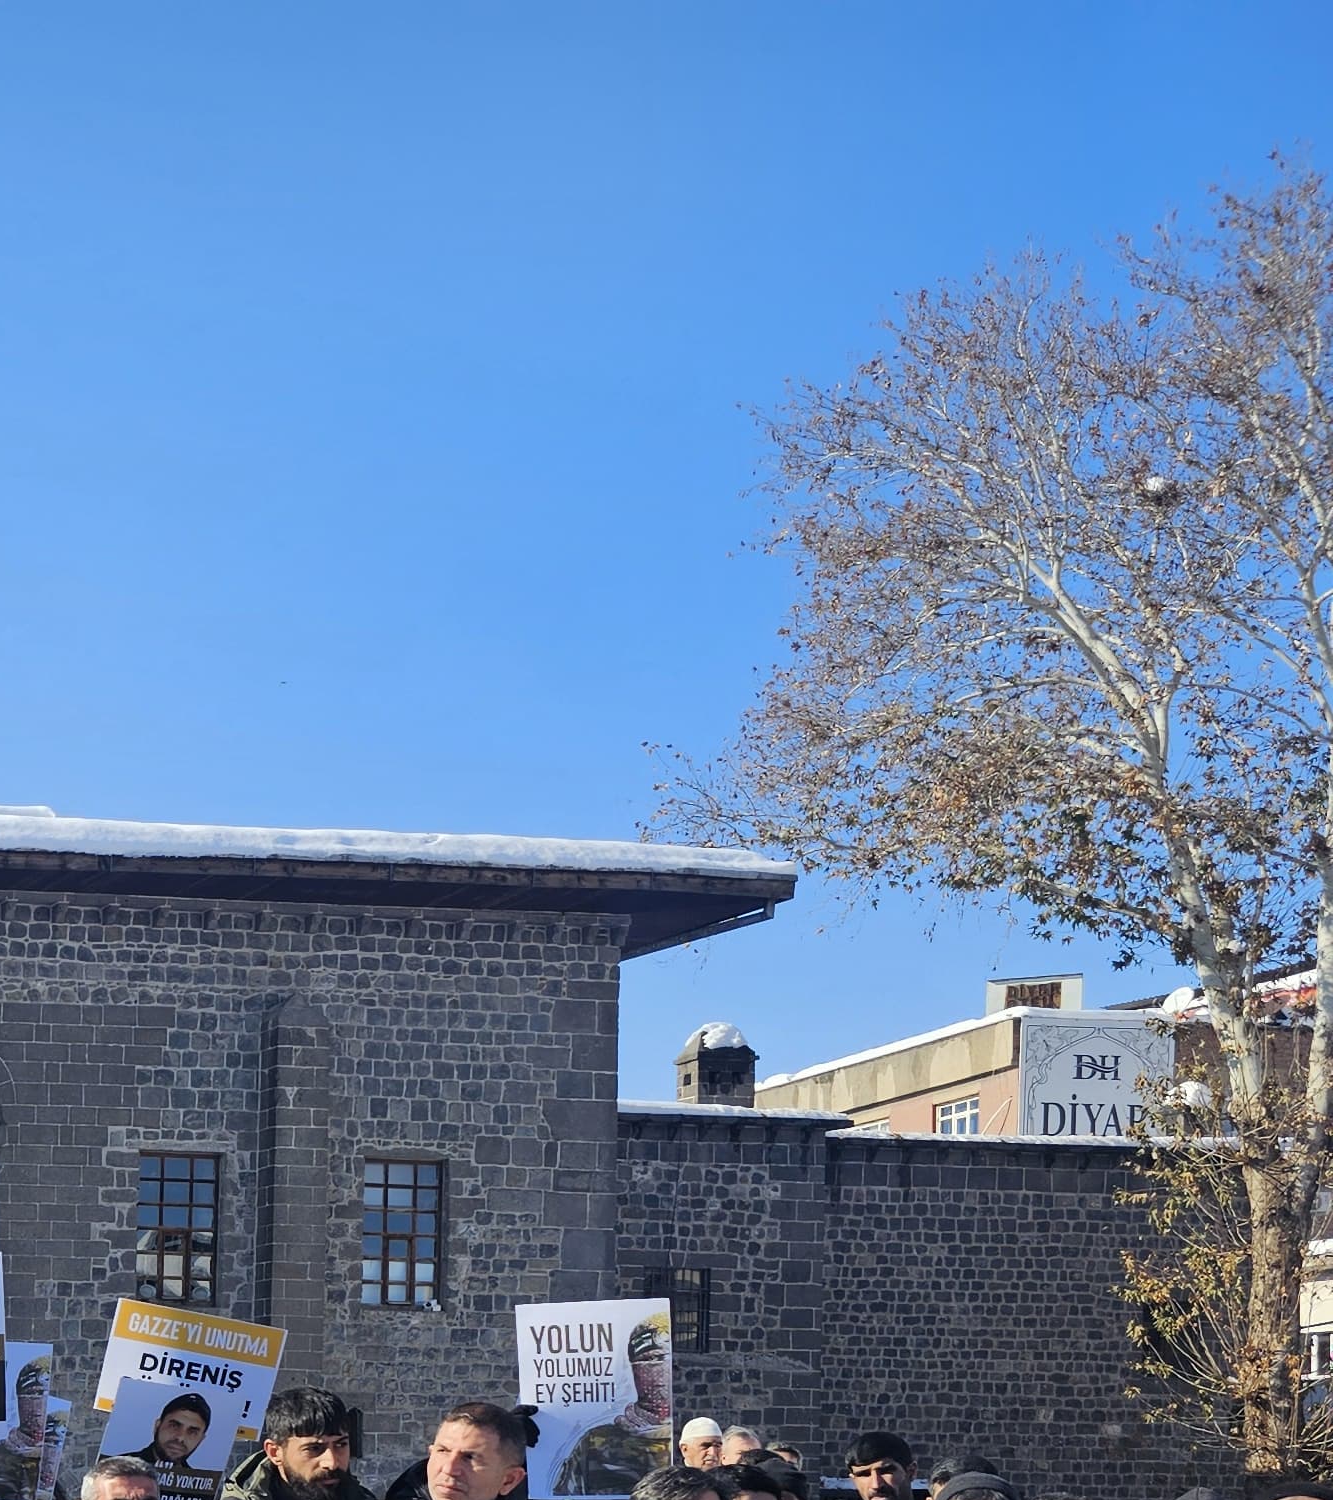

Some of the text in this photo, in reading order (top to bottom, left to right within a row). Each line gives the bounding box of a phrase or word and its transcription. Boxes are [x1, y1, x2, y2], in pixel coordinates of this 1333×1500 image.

[128, 1312, 269, 1358] GAZZE'Yİ UNUTMA
[530, 1322, 614, 1354] YOLUN
[139, 1351, 244, 1393] DİRENİŞ
[533, 1357, 614, 1378] YOLUMUZ
[536, 1379, 616, 1407] EY ŞEHİT!
